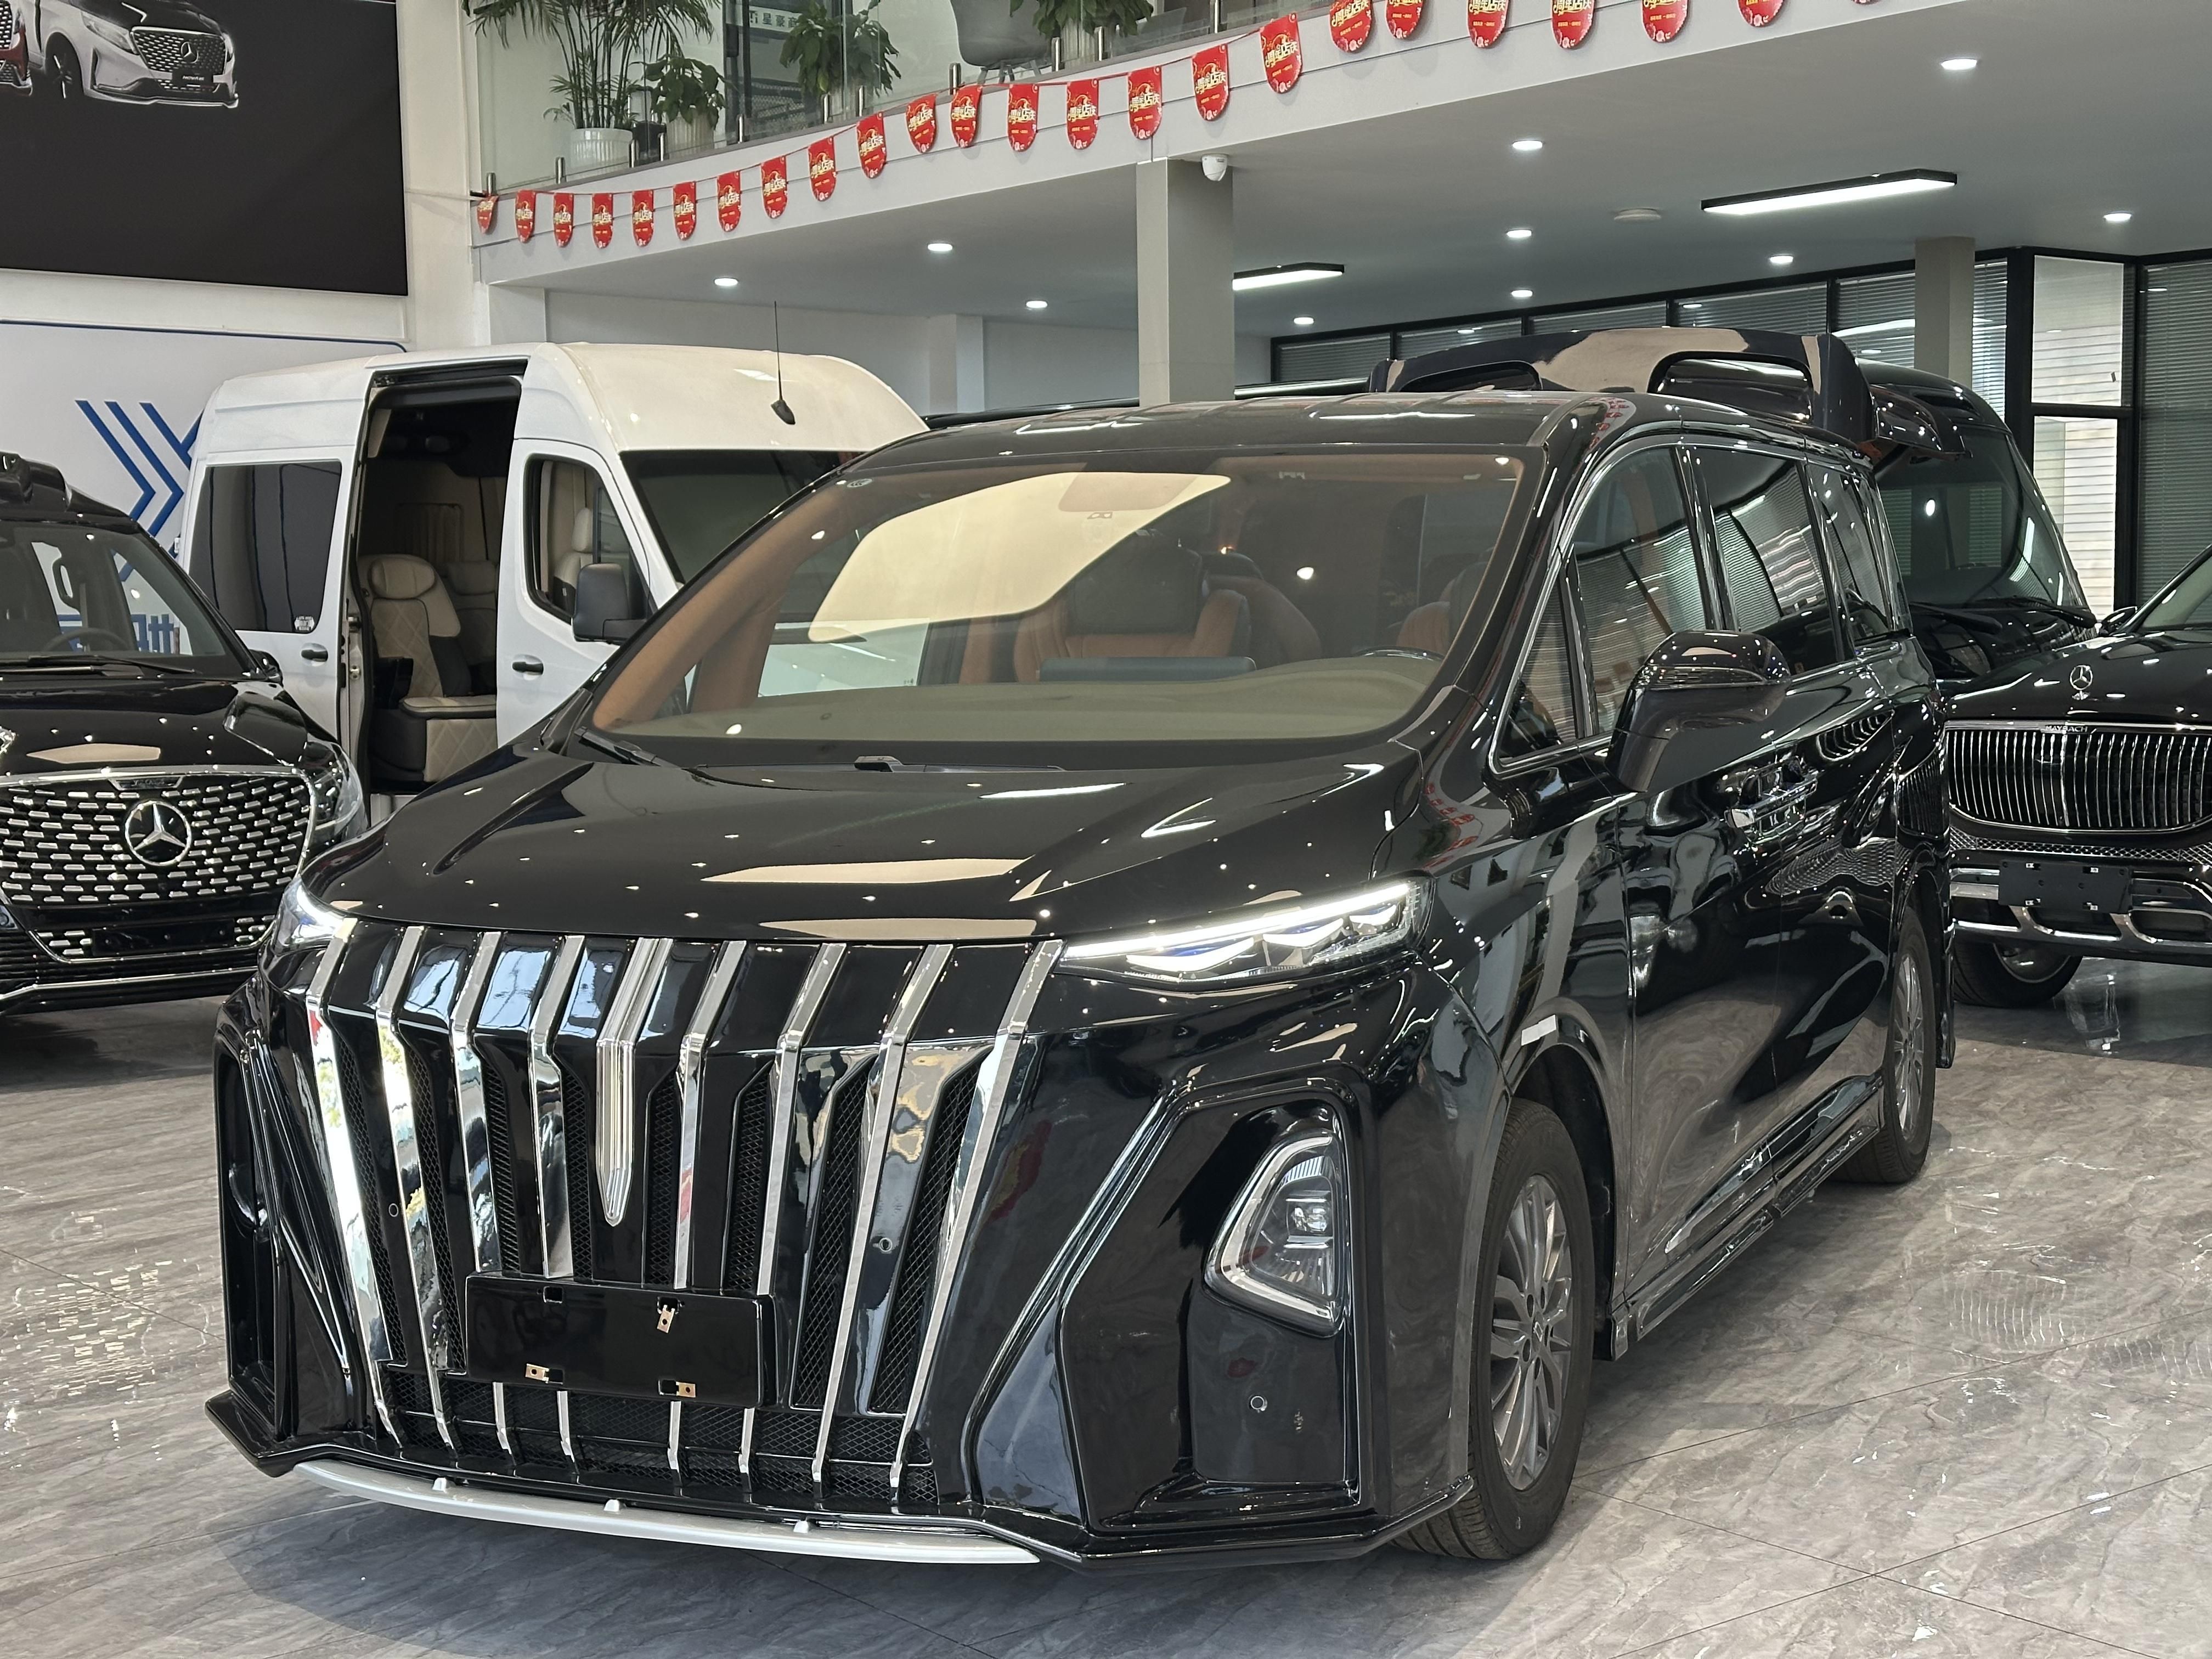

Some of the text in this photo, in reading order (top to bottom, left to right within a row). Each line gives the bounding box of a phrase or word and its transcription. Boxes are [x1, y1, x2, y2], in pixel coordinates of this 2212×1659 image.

[1265, 41, 1298, 67] 周年店庆
[1195, 71, 1227, 94] 周年店庆
[1130, 92, 1160, 111] 周年店庆
[1068, 103, 1097, 122] 周年店庆
